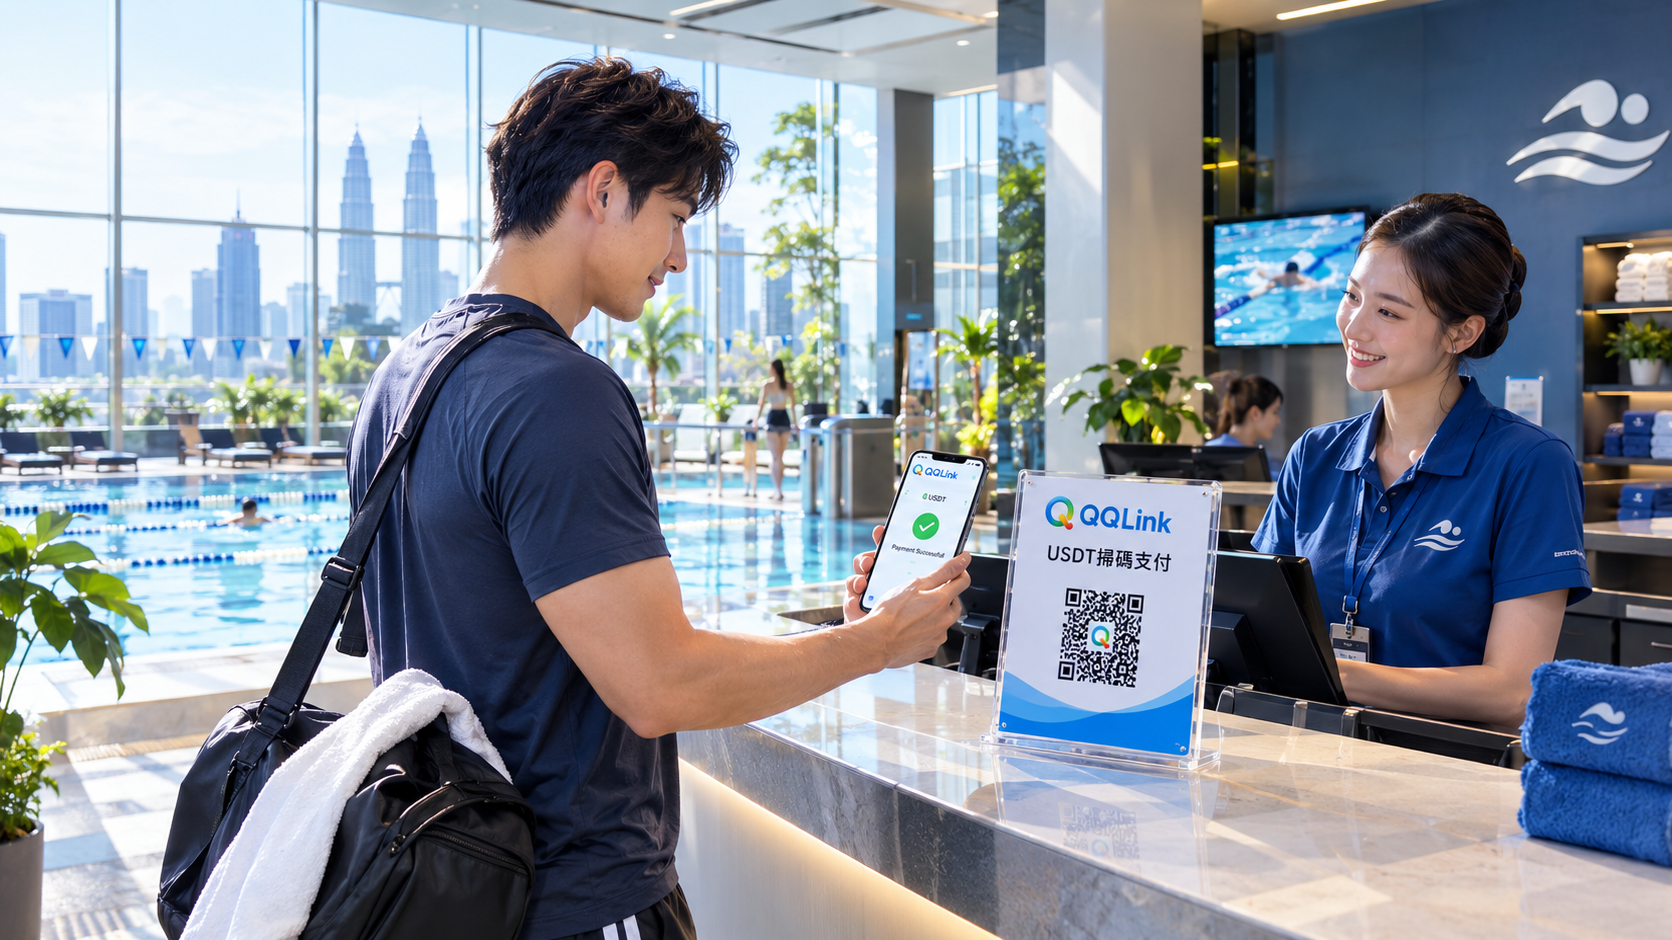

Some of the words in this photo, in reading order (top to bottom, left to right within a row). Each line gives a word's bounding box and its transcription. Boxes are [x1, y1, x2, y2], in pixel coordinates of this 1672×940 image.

[924, 467, 958, 479] QQLink
[928, 494, 947, 502] USDT
[1079, 503, 1172, 534] QQLink
[891, 543, 915, 553] Payment
[1047, 544, 1172, 573] USDT掃碼支付
